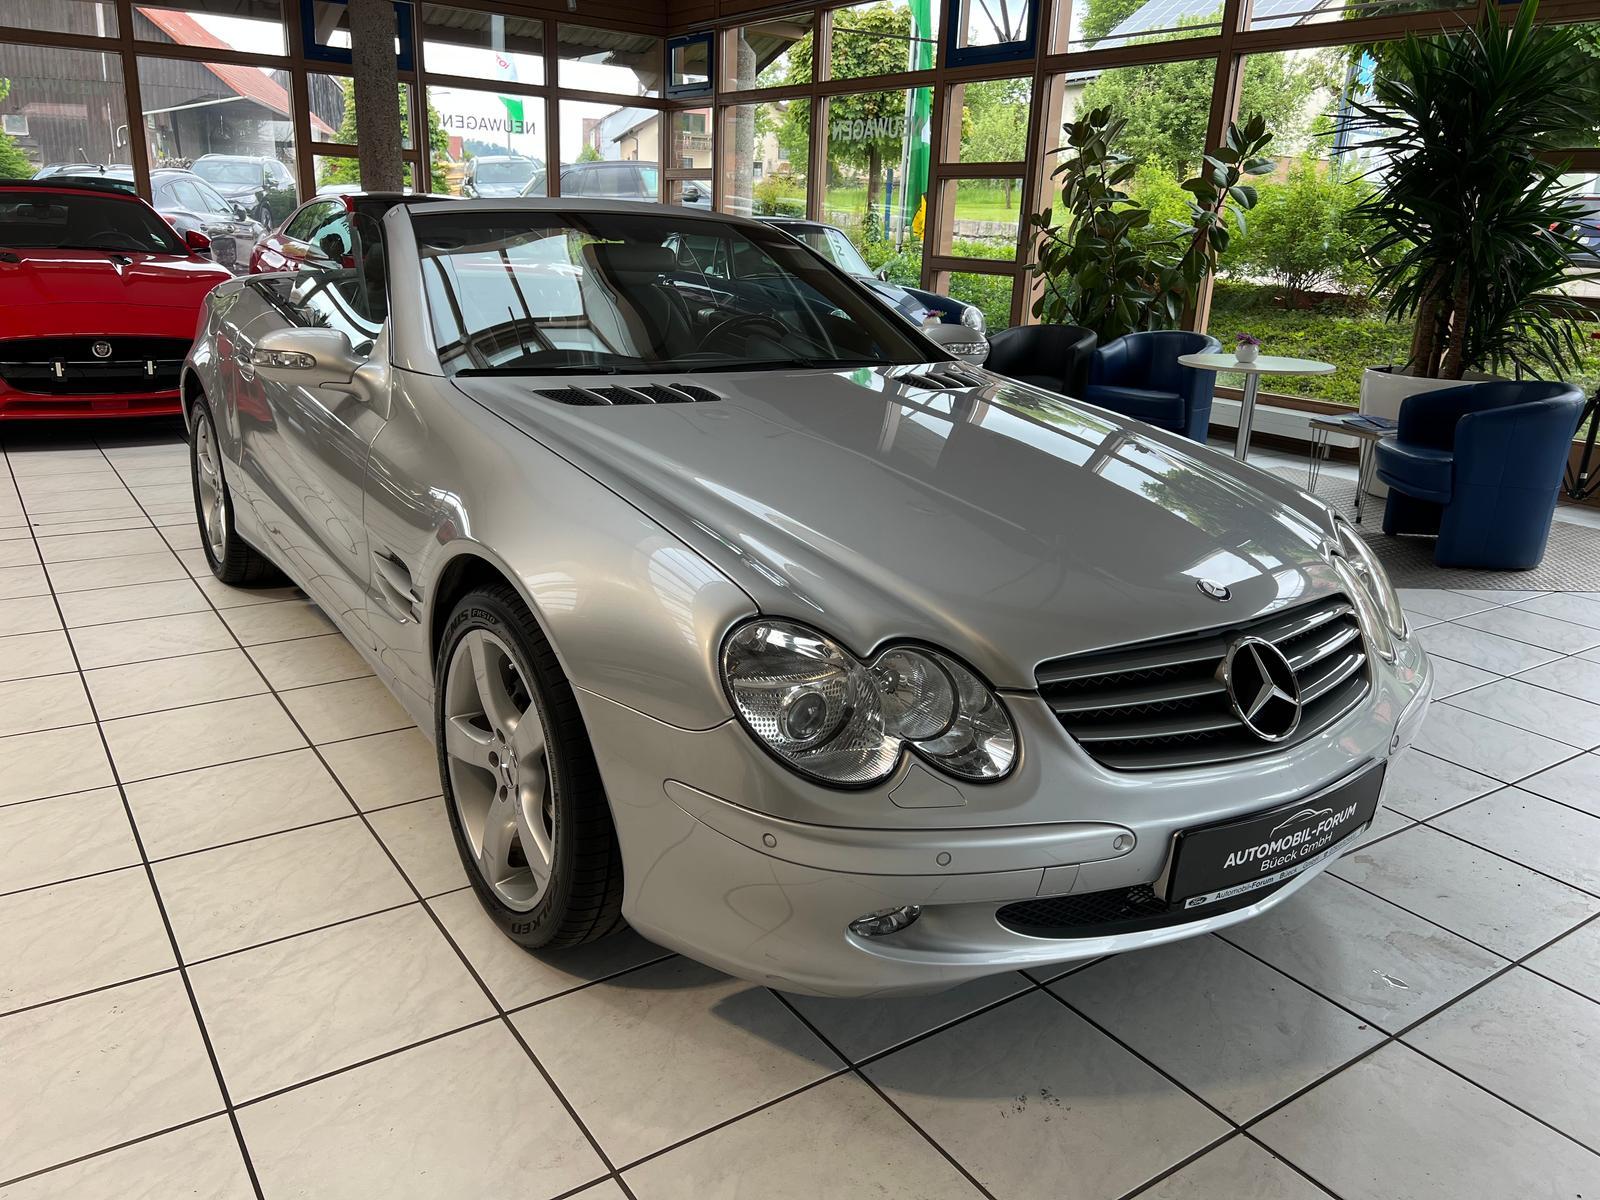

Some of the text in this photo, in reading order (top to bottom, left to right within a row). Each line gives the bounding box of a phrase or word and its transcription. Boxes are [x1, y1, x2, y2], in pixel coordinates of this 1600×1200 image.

[1223, 802, 1357, 869] AUTOMOBIL-FORUM
[1260, 849, 1298, 872] Büeck
[1300, 831, 1333, 856] GmbH
